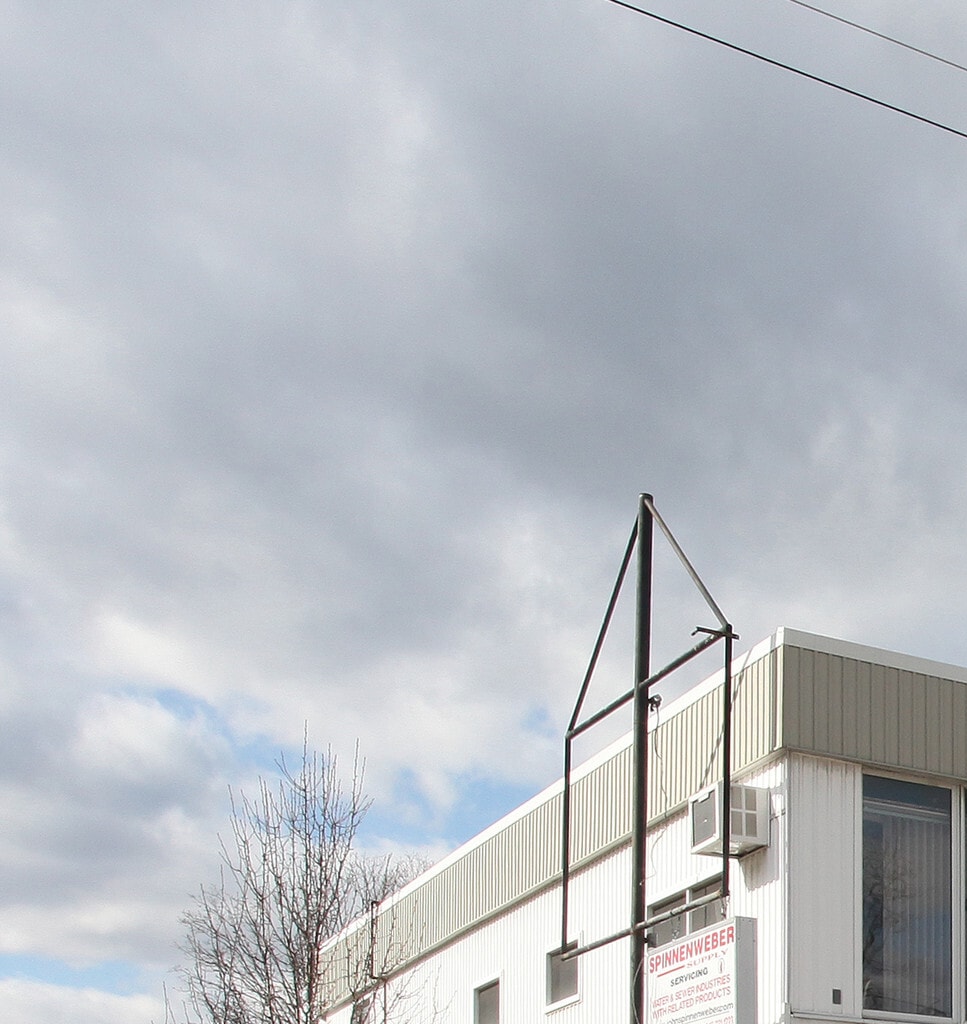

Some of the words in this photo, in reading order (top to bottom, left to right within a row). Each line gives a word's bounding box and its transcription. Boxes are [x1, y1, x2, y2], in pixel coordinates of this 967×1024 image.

[649, 926, 735, 974] SPINNENWEBER
[686, 948, 729, 969] SUPPLY
[651, 995, 670, 1009] WATER
[675, 987, 695, 1001] SEWER
[696, 974, 731, 994] INDUSTRIES
[670, 967, 709, 988] SERVICING
[652, 1007, 667, 1020] WITH
[667, 998, 695, 1014] RELATED
[695, 986, 731, 1005] PRODUCTS
